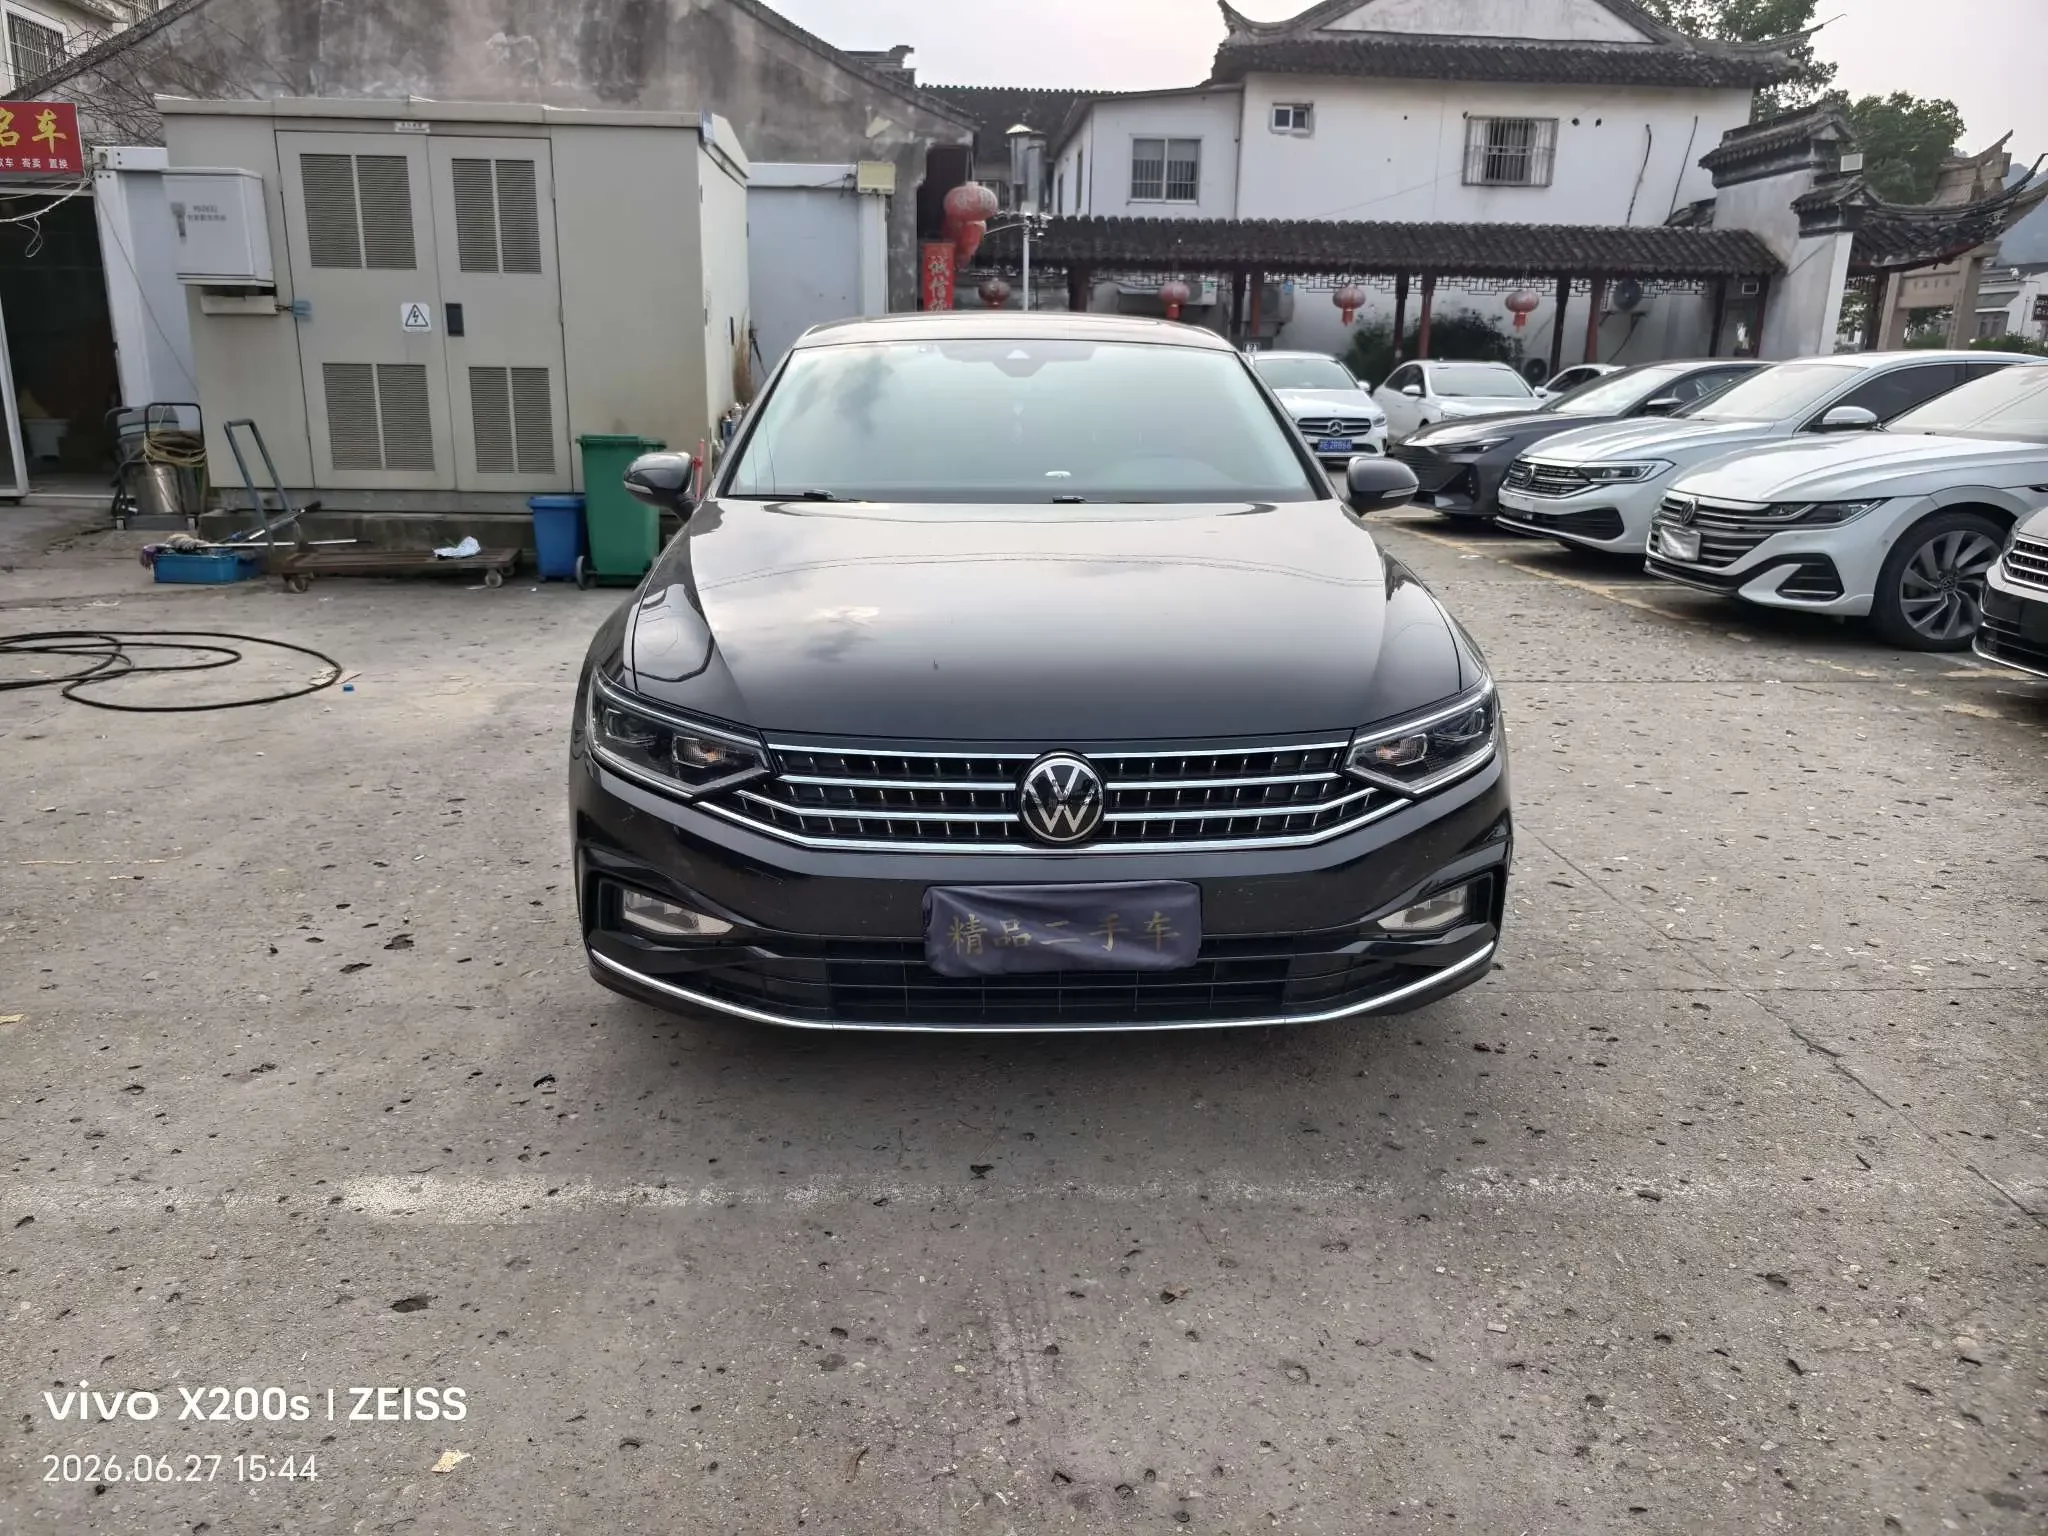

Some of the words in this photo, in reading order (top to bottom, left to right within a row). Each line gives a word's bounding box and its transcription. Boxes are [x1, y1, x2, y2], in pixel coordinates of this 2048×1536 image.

[946, 911, 1181, 955] 精品二手车
